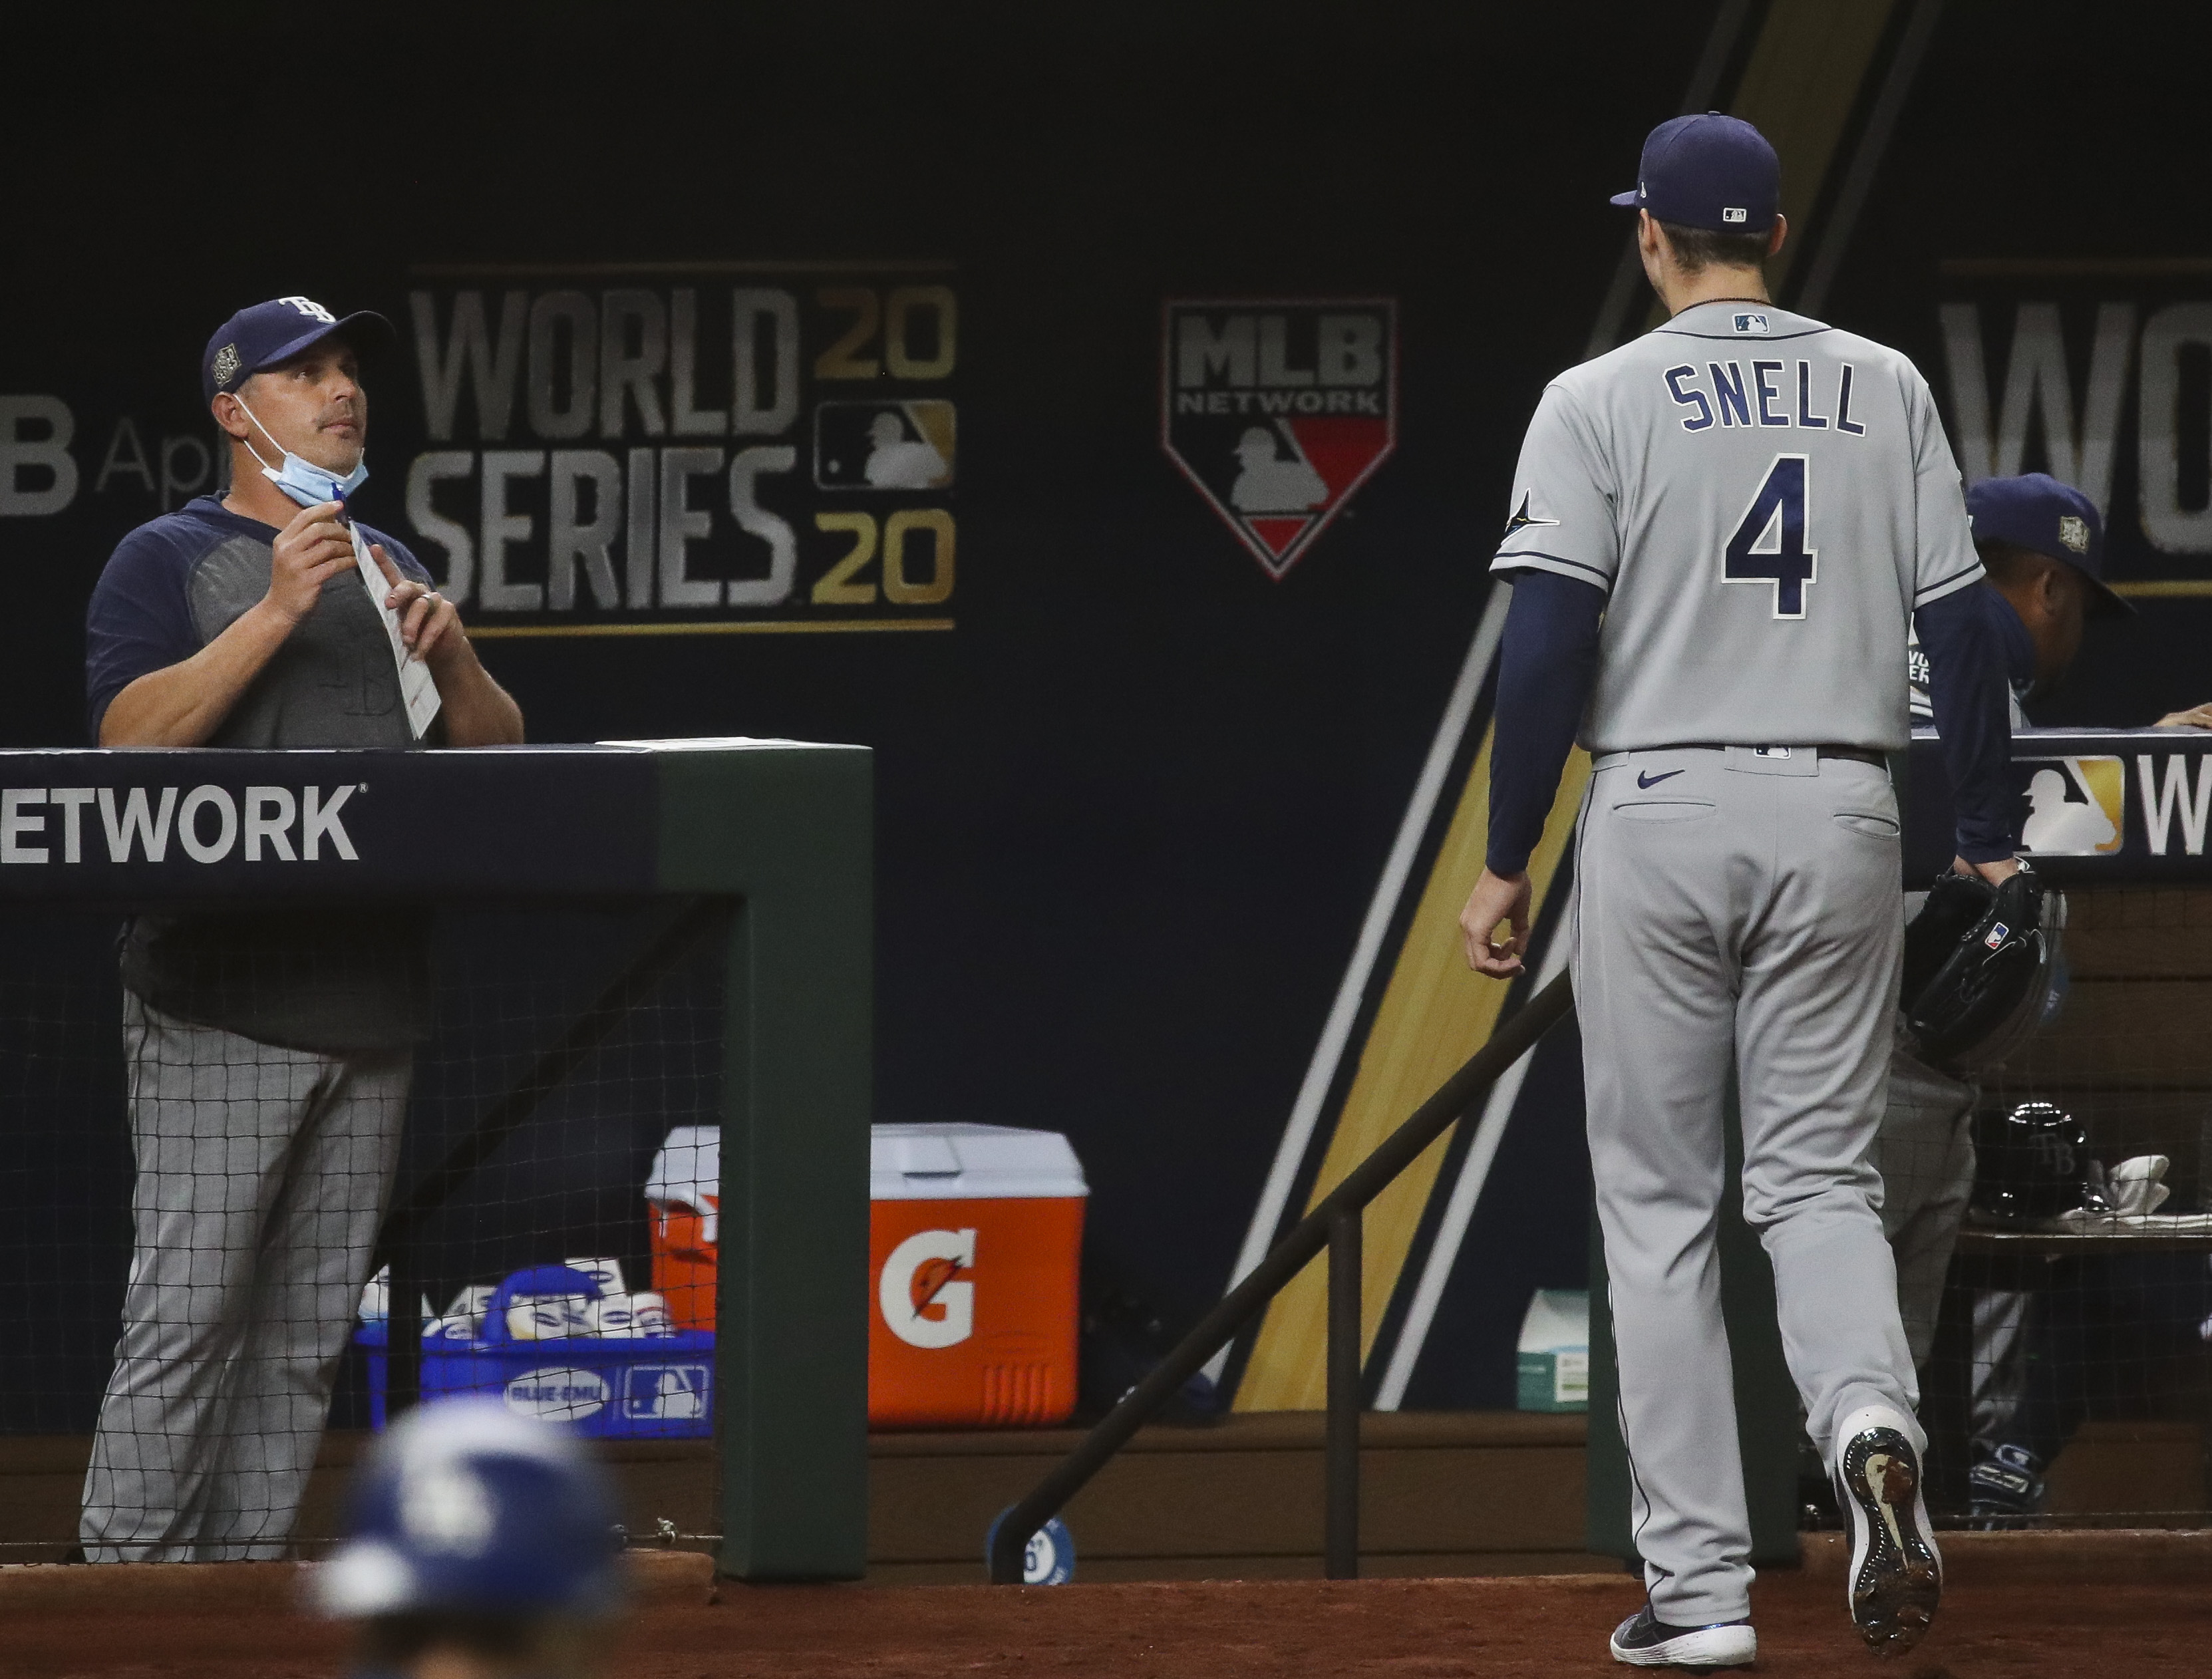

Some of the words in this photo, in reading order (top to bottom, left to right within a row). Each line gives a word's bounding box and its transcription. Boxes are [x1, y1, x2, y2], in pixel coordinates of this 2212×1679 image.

[409, 285, 800, 440] WORLD
[814, 285, 958, 381] 20
[1178, 315, 1382, 388] MLB
[1178, 390, 1382, 415] NETWORK
[1663, 359, 1866, 437] SNELL
[94, 416, 232, 512] Ap
[404, 445, 798, 613] SERIES
[810, 508, 957, 606] 20
[1721, 452, 1819, 620] 4
[2137, 754, 2212, 856] W
[879, 1227, 979, 1349] G
